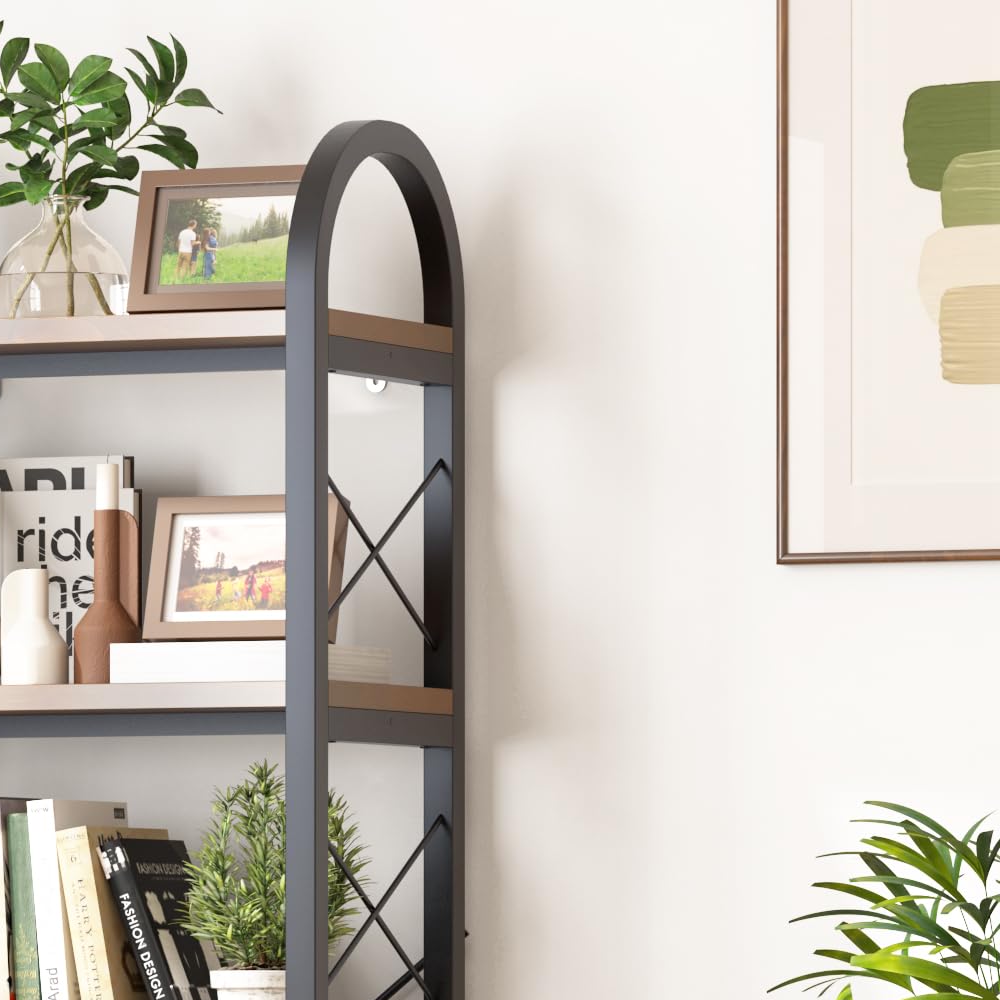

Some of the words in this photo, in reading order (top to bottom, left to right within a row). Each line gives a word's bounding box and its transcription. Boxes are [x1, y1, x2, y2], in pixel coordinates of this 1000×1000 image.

[77, 878, 93, 935] HARRY
[119, 893, 147, 951] FASHION
[140, 951, 165, 1000] DESIGN
